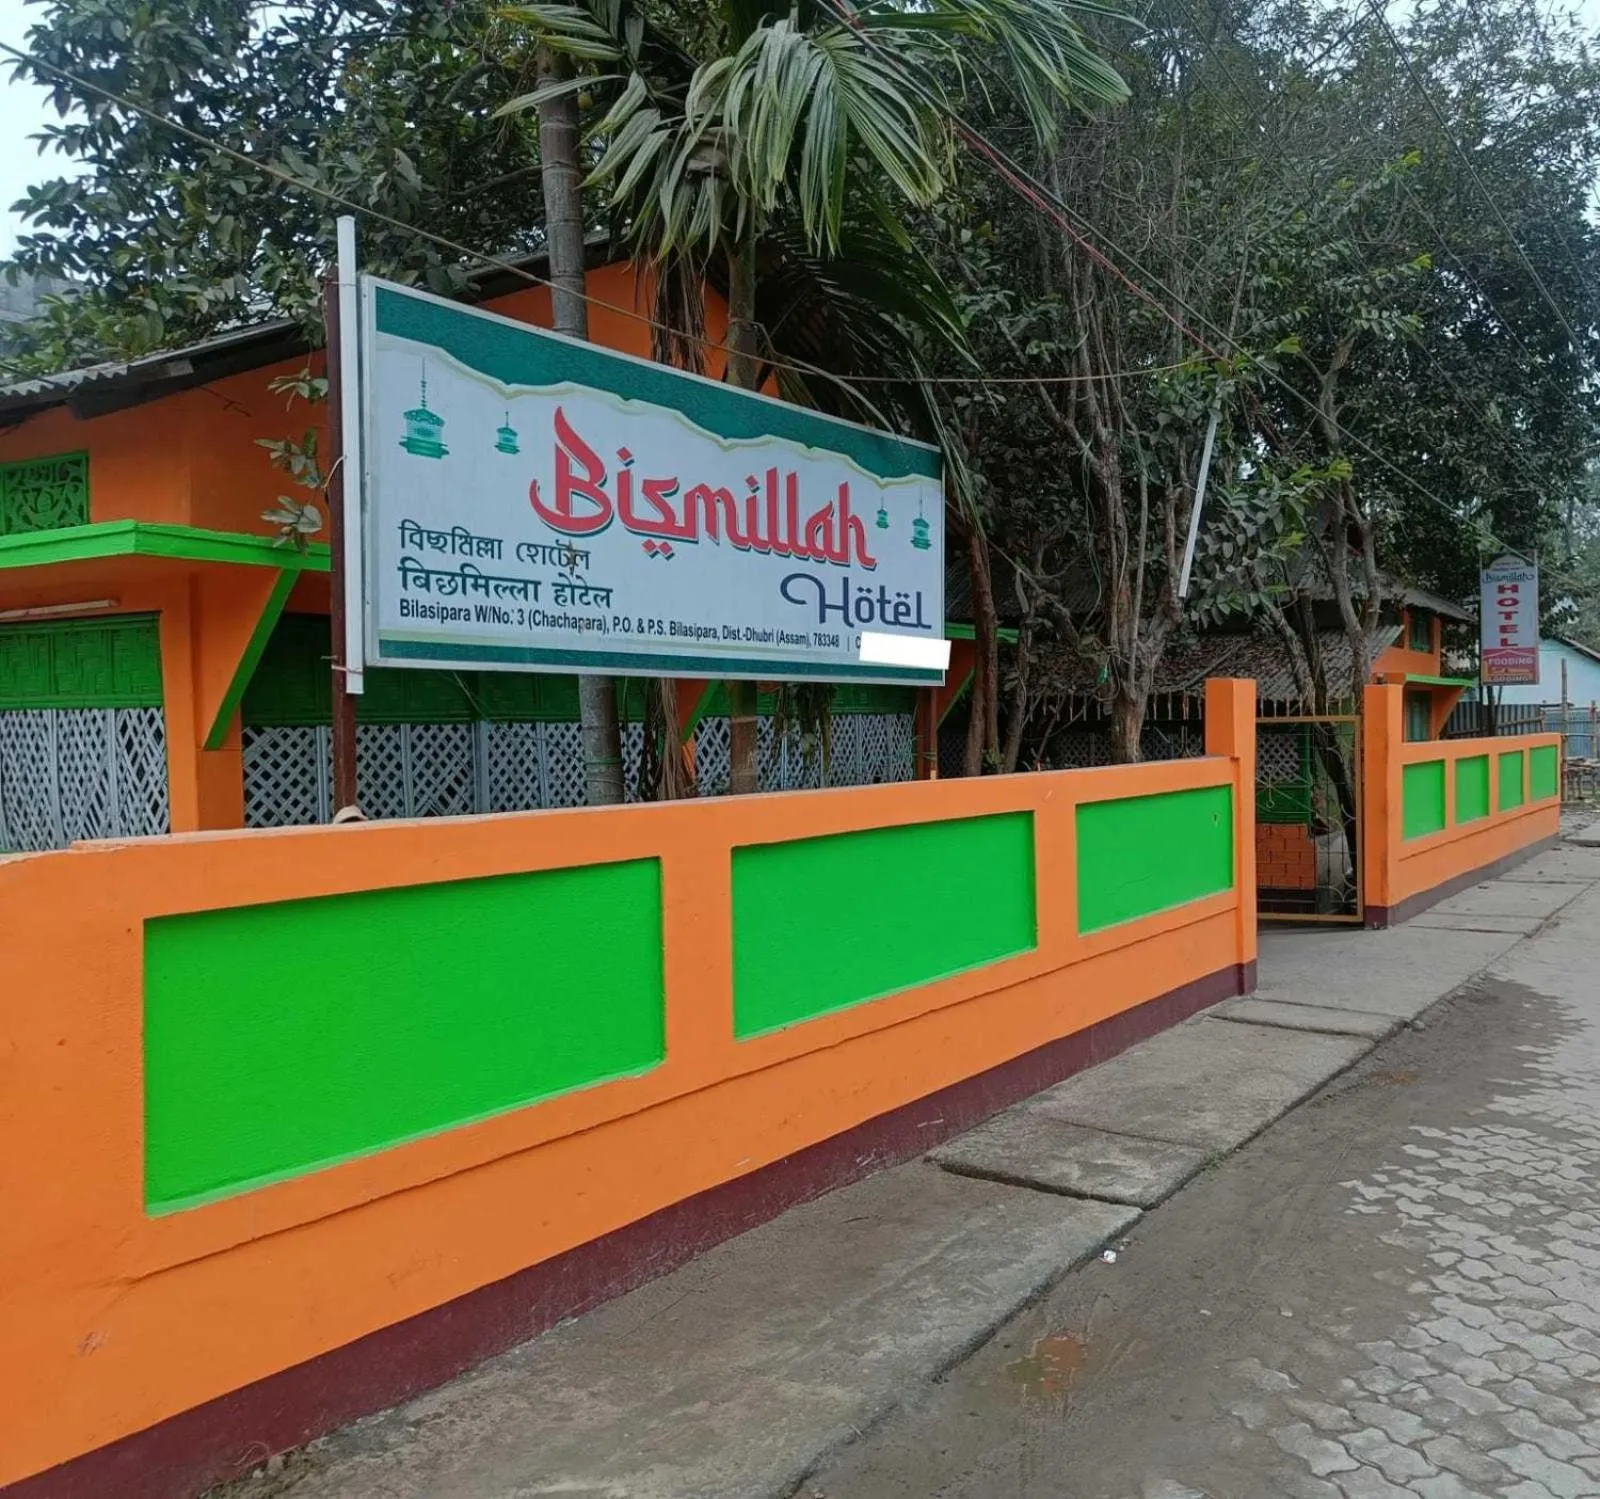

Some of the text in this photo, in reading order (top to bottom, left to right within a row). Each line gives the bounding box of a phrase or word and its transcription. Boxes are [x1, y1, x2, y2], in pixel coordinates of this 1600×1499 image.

[529, 405, 877, 571] Bismillah
[399, 598, 471, 624] Bilasipara
[517, 608, 525, 626] 3
[528, 609, 610, 634] (Chachapara),
[613, 617, 634, 634] P.O.
[637, 620, 645, 634] &
[647, 622, 667, 636] P.S.
[669, 623, 720, 641] Bilasipara,
[813, 634, 839, 648] 783348
[1497, 584, 1519, 647] HOTEL
